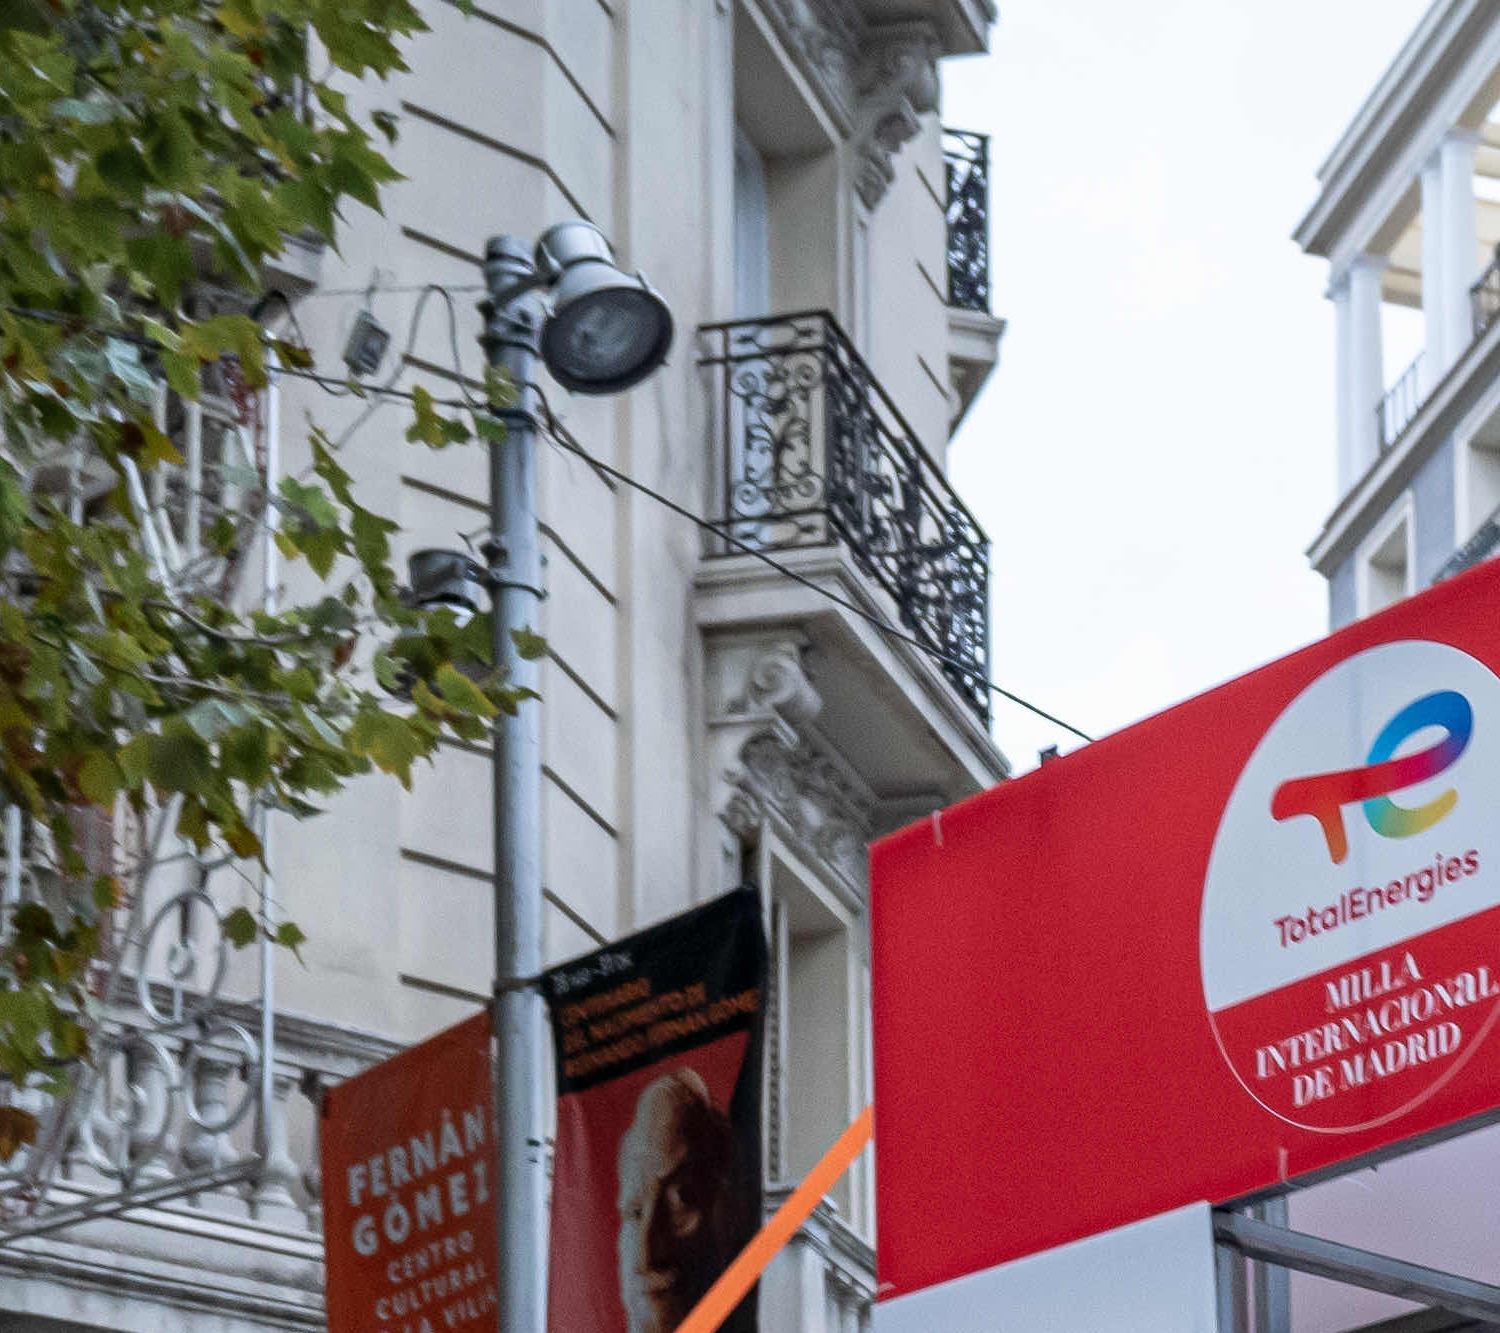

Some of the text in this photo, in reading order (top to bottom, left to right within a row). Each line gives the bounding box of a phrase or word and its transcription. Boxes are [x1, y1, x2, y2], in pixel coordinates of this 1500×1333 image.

[1273, 848, 1479, 949] TotalEnergies
[1256, 967, 1500, 1080] INTERNACIONAL
[1325, 951, 1422, 1015] MILLA
[1293, 1021, 1462, 1107] DE MADRID
[348, 1104, 486, 1206] FERNÁN
[375, 1258, 489, 1321] CULTURAL
[387, 1229, 474, 1284] CENTRO
